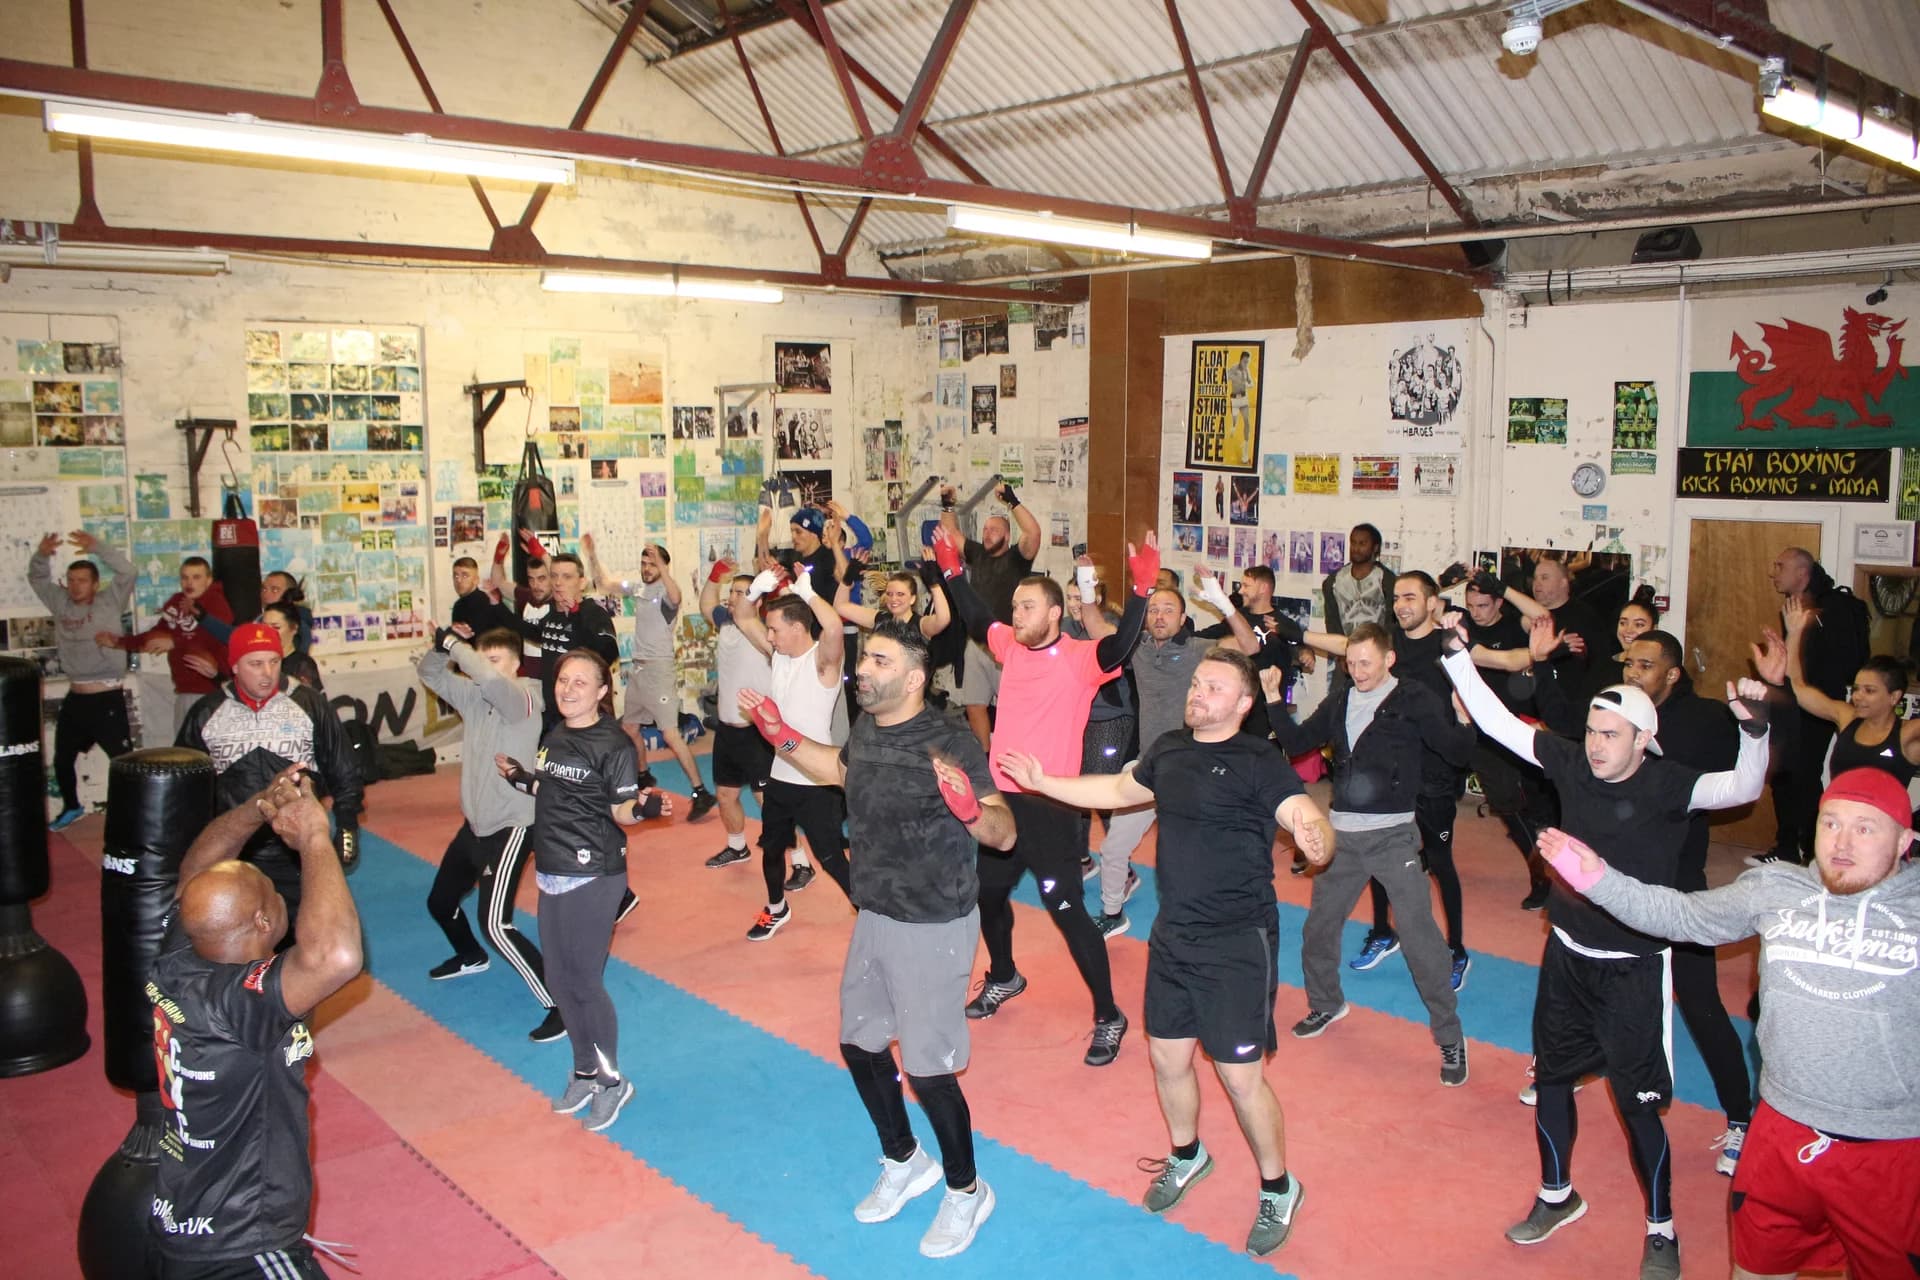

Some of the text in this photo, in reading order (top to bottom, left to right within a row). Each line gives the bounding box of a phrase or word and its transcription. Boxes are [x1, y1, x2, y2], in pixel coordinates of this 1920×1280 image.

[1199, 351, 1229, 367] FLOAT
[1198, 367, 1228, 385] LIKE A
[1197, 385, 1228, 396] BUTTERFLY
[1196, 398, 1227, 416] STING
[1195, 416, 1225, 434] LIKE A
[1193, 433, 1225, 462] BEE
[1703, 452, 1857, 475] THAI BOXING
[1681, 475, 1880, 497] KICK BOXING MMA
[1842, 981, 1886, 1000] CLOTHING
